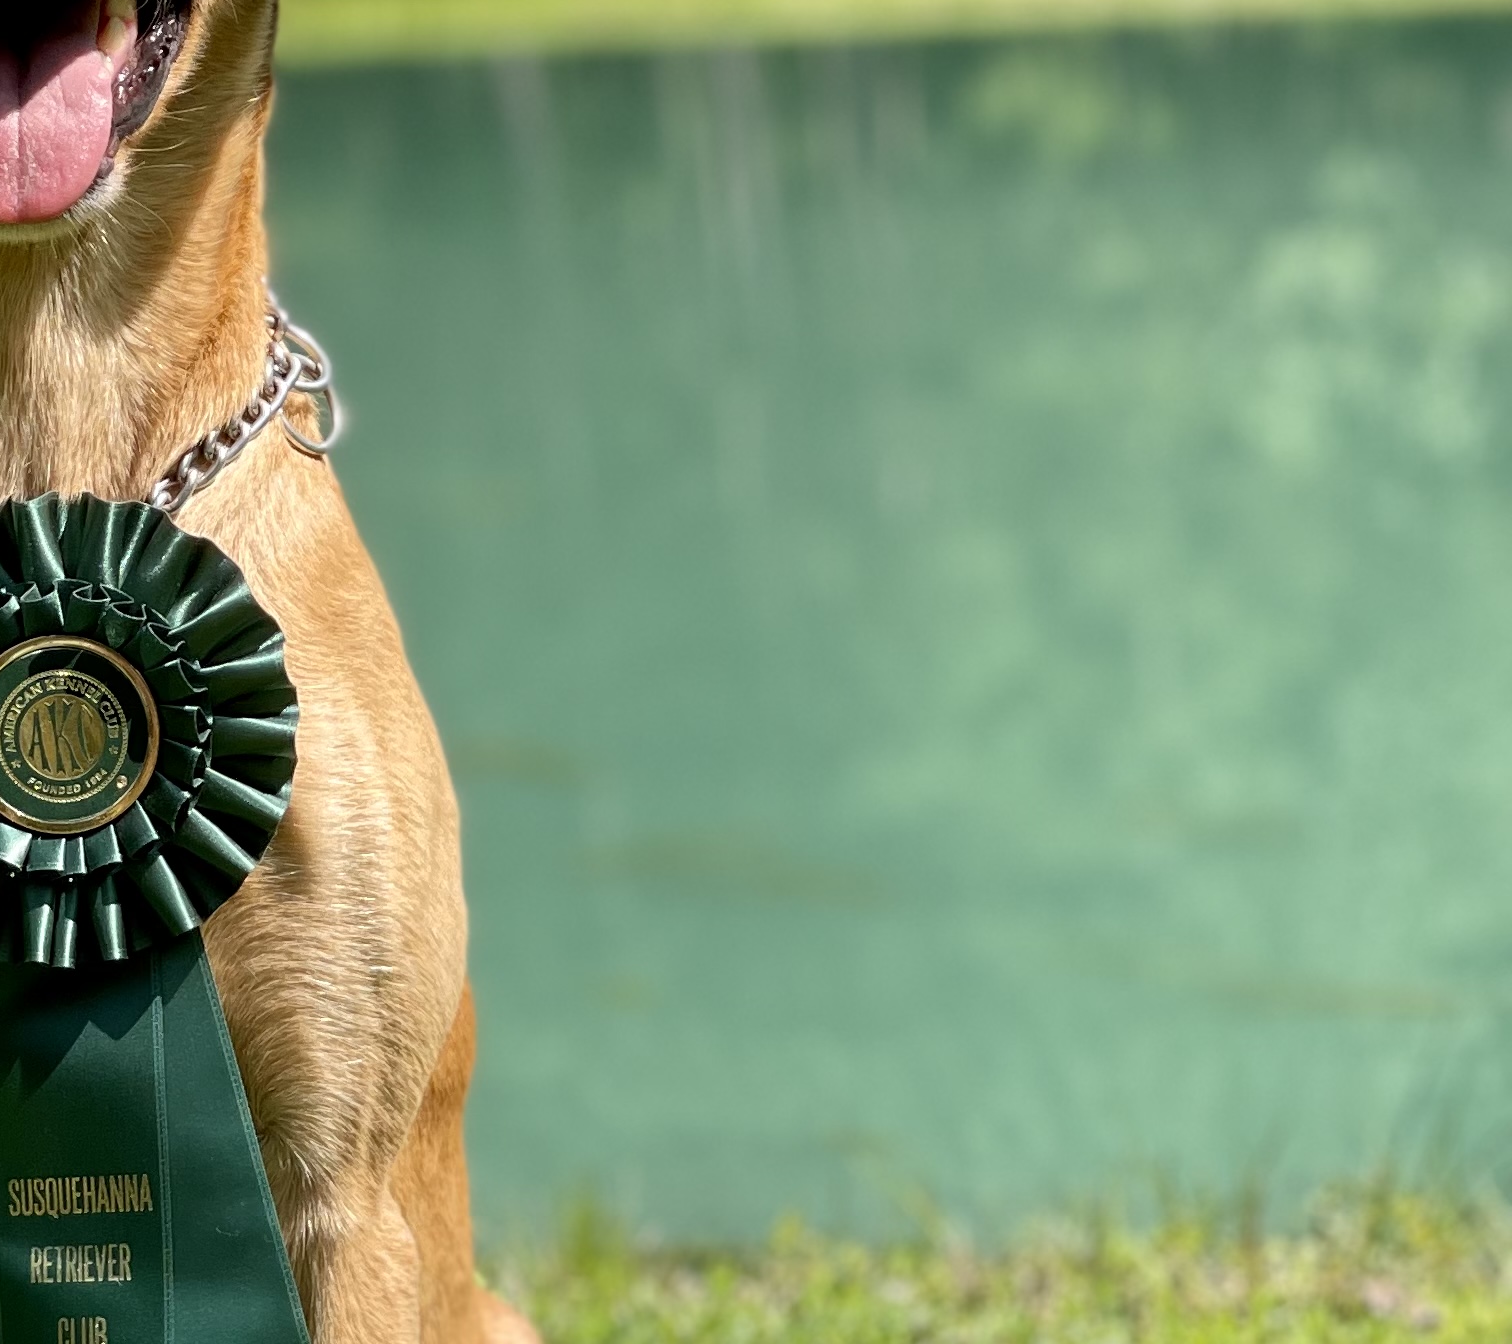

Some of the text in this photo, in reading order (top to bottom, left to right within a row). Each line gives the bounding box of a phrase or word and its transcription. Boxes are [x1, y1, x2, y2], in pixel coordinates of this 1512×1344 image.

[26, 777, 82, 795] FOUNDED
[7, 1173, 154, 1219] SUSQUEHANNA
[30, 1243, 132, 1284] RETRIEVER
